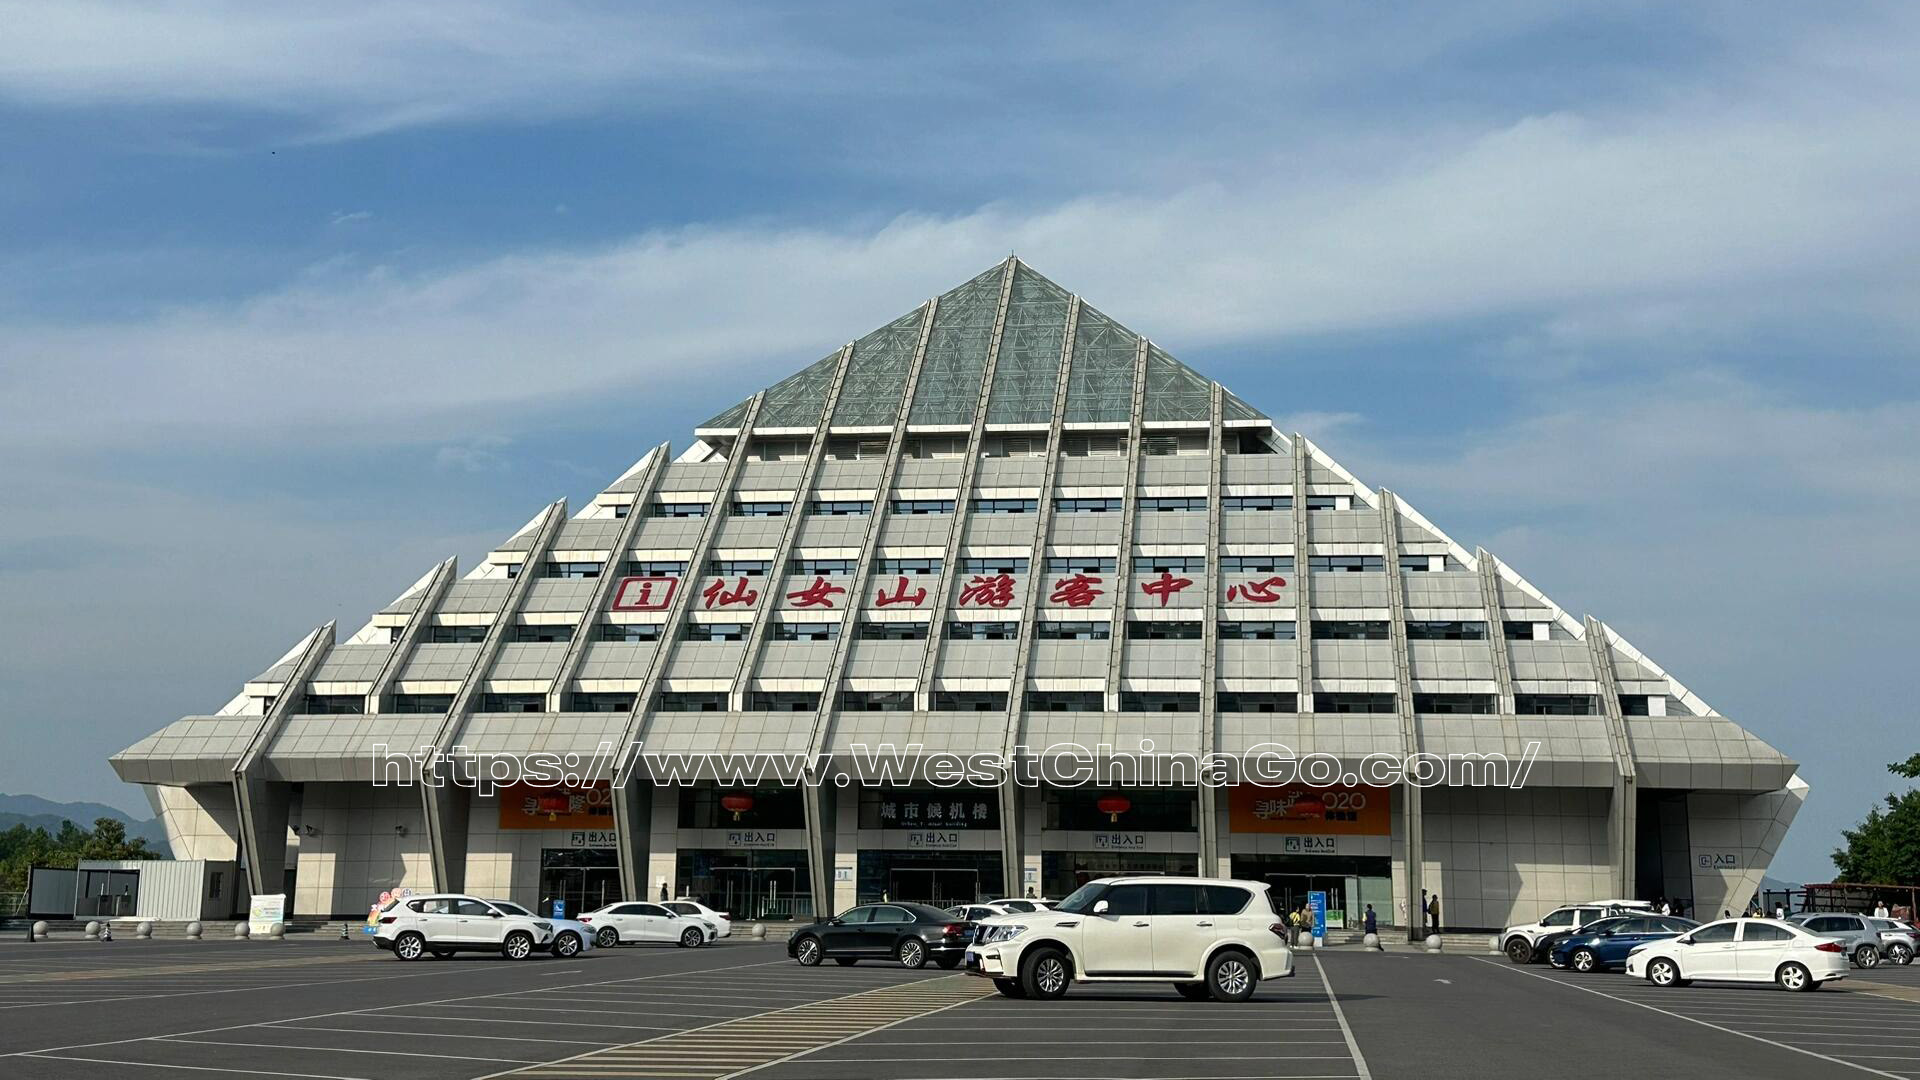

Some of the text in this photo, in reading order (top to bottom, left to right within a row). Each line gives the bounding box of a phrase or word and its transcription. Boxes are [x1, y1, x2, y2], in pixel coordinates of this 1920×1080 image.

[702, 572, 1287, 609] 仙女山游客中心
[880, 801, 988, 820] 城市候机楼
[588, 832, 617, 843] 出入口
[744, 832, 775, 842] 出入口
[926, 832, 958, 843] 出入口
[1112, 833, 1144, 845] 出入口
[1303, 837, 1335, 848] 出入口
[1714, 853, 1736, 864] 入口
